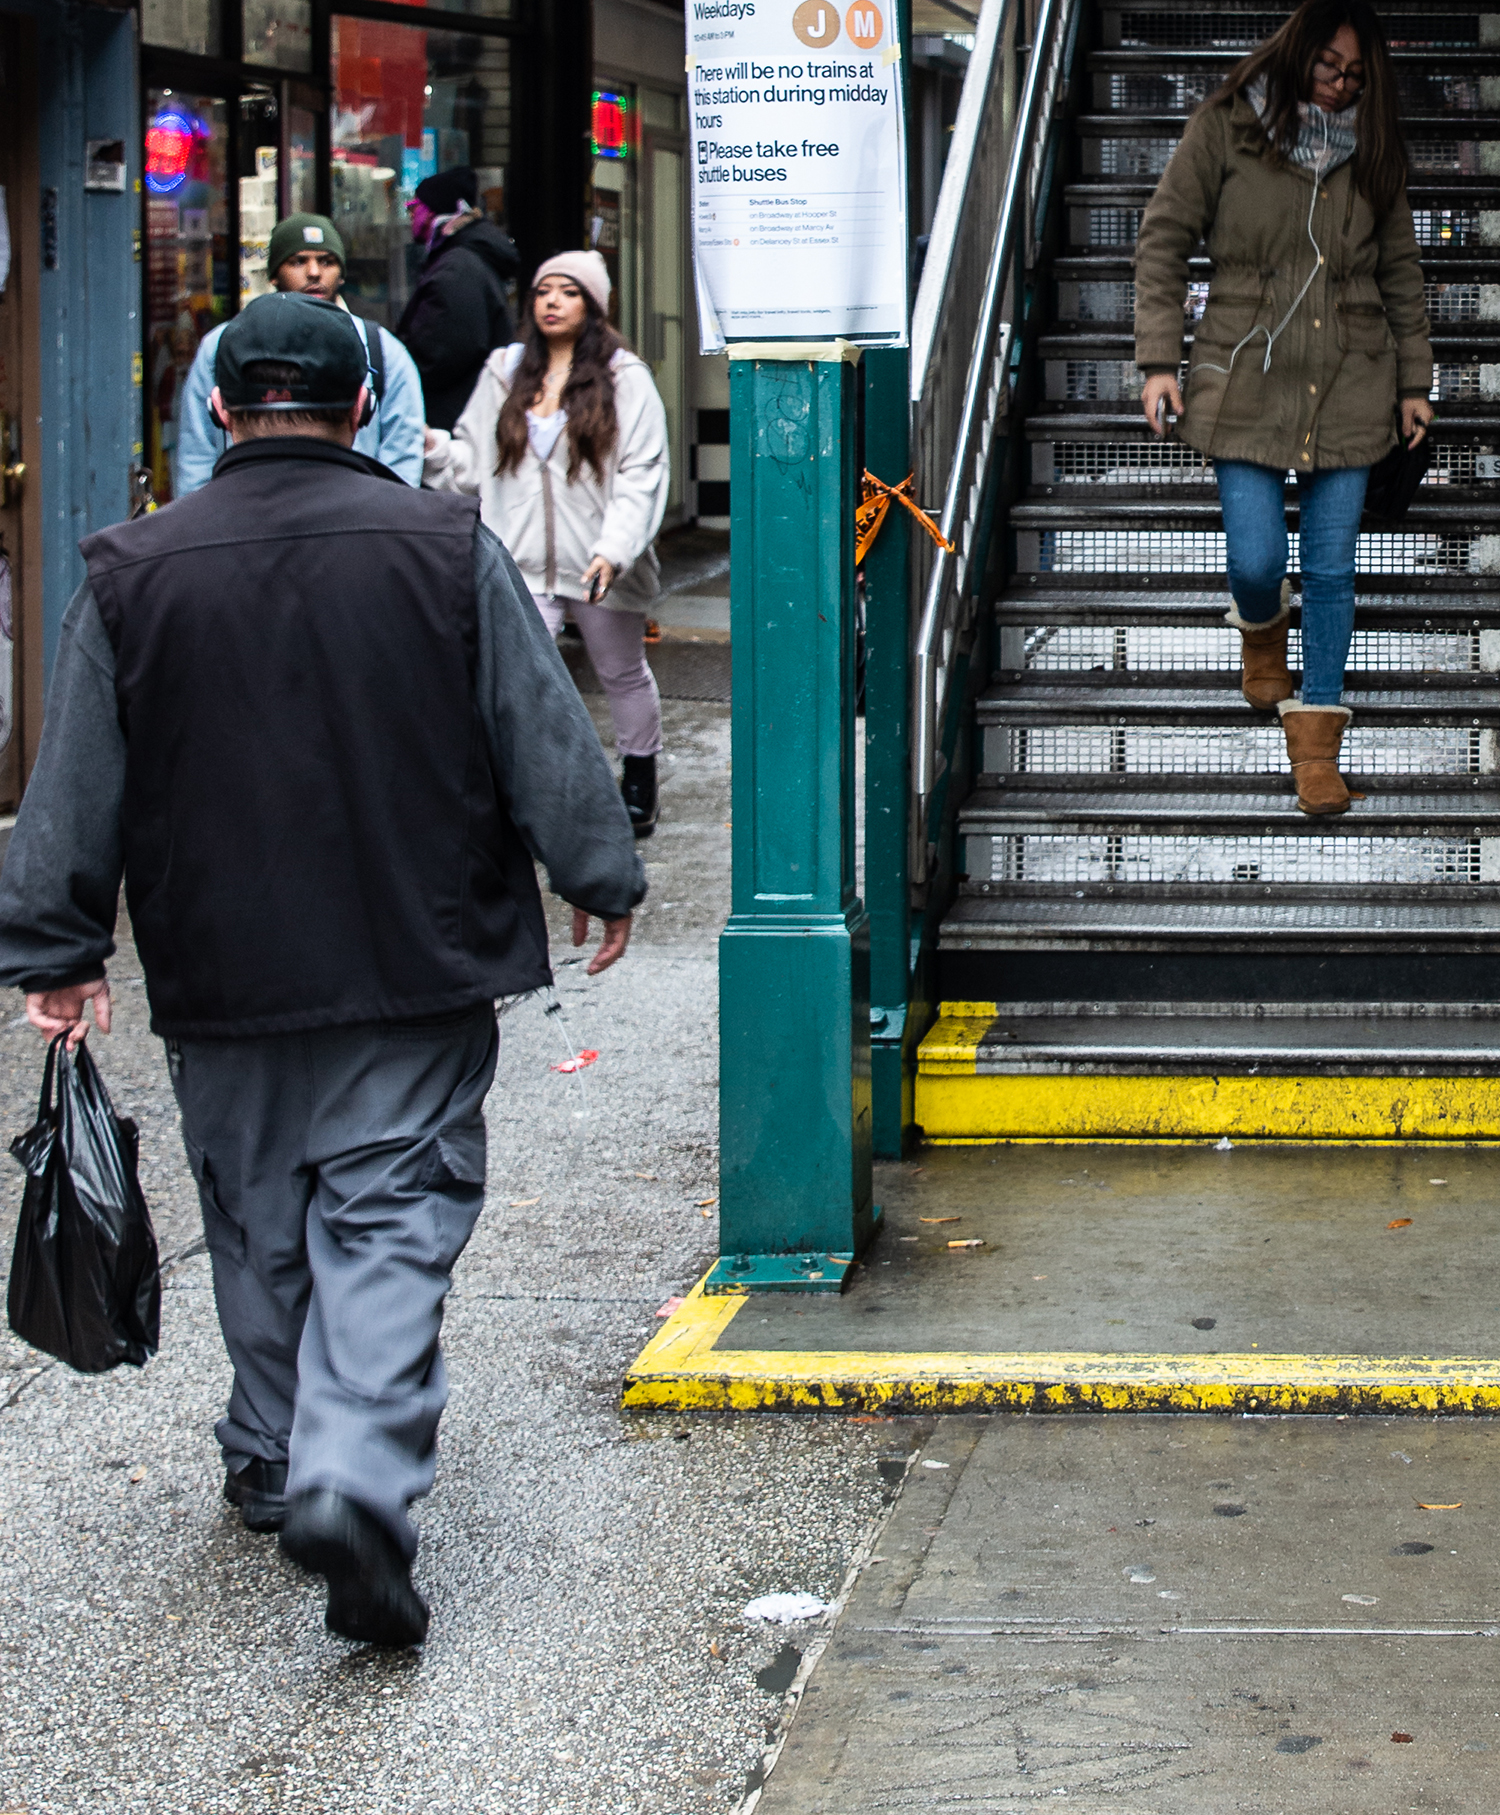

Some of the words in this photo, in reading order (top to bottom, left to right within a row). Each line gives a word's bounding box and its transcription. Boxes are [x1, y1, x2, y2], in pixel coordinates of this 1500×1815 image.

[693, 0, 756, 20] Weekdays
[806, 9, 827, 39] J
[853, 10, 876, 39] M
[695, 64, 723, 83] There
[725, 61, 748, 80] will
[751, 62, 775, 80] be
[778, 65, 804, 79] no
[807, 61, 857, 79] trains
[860, 62, 875, 79] at
[694, 89, 712, 106] this
[712, 86, 761, 104] station
[763, 85, 825, 105] during
[829, 84, 888, 106] midday
[696, 113, 722, 130] hours
[709, 141, 752, 160] Please
[756, 140, 798, 158] take
[801, 140, 839, 157] free
[698, 165, 729, 183] shuttle
[732, 164, 787, 182] buses
[749, 198, 774, 207] Shuttle
[775, 198, 789, 206] Bus
[790, 197, 808, 207] Stop
[758, 211, 793, 221] Broadway
[758, 224, 793, 234] Broadway
[802, 224, 825, 233] Marcy
